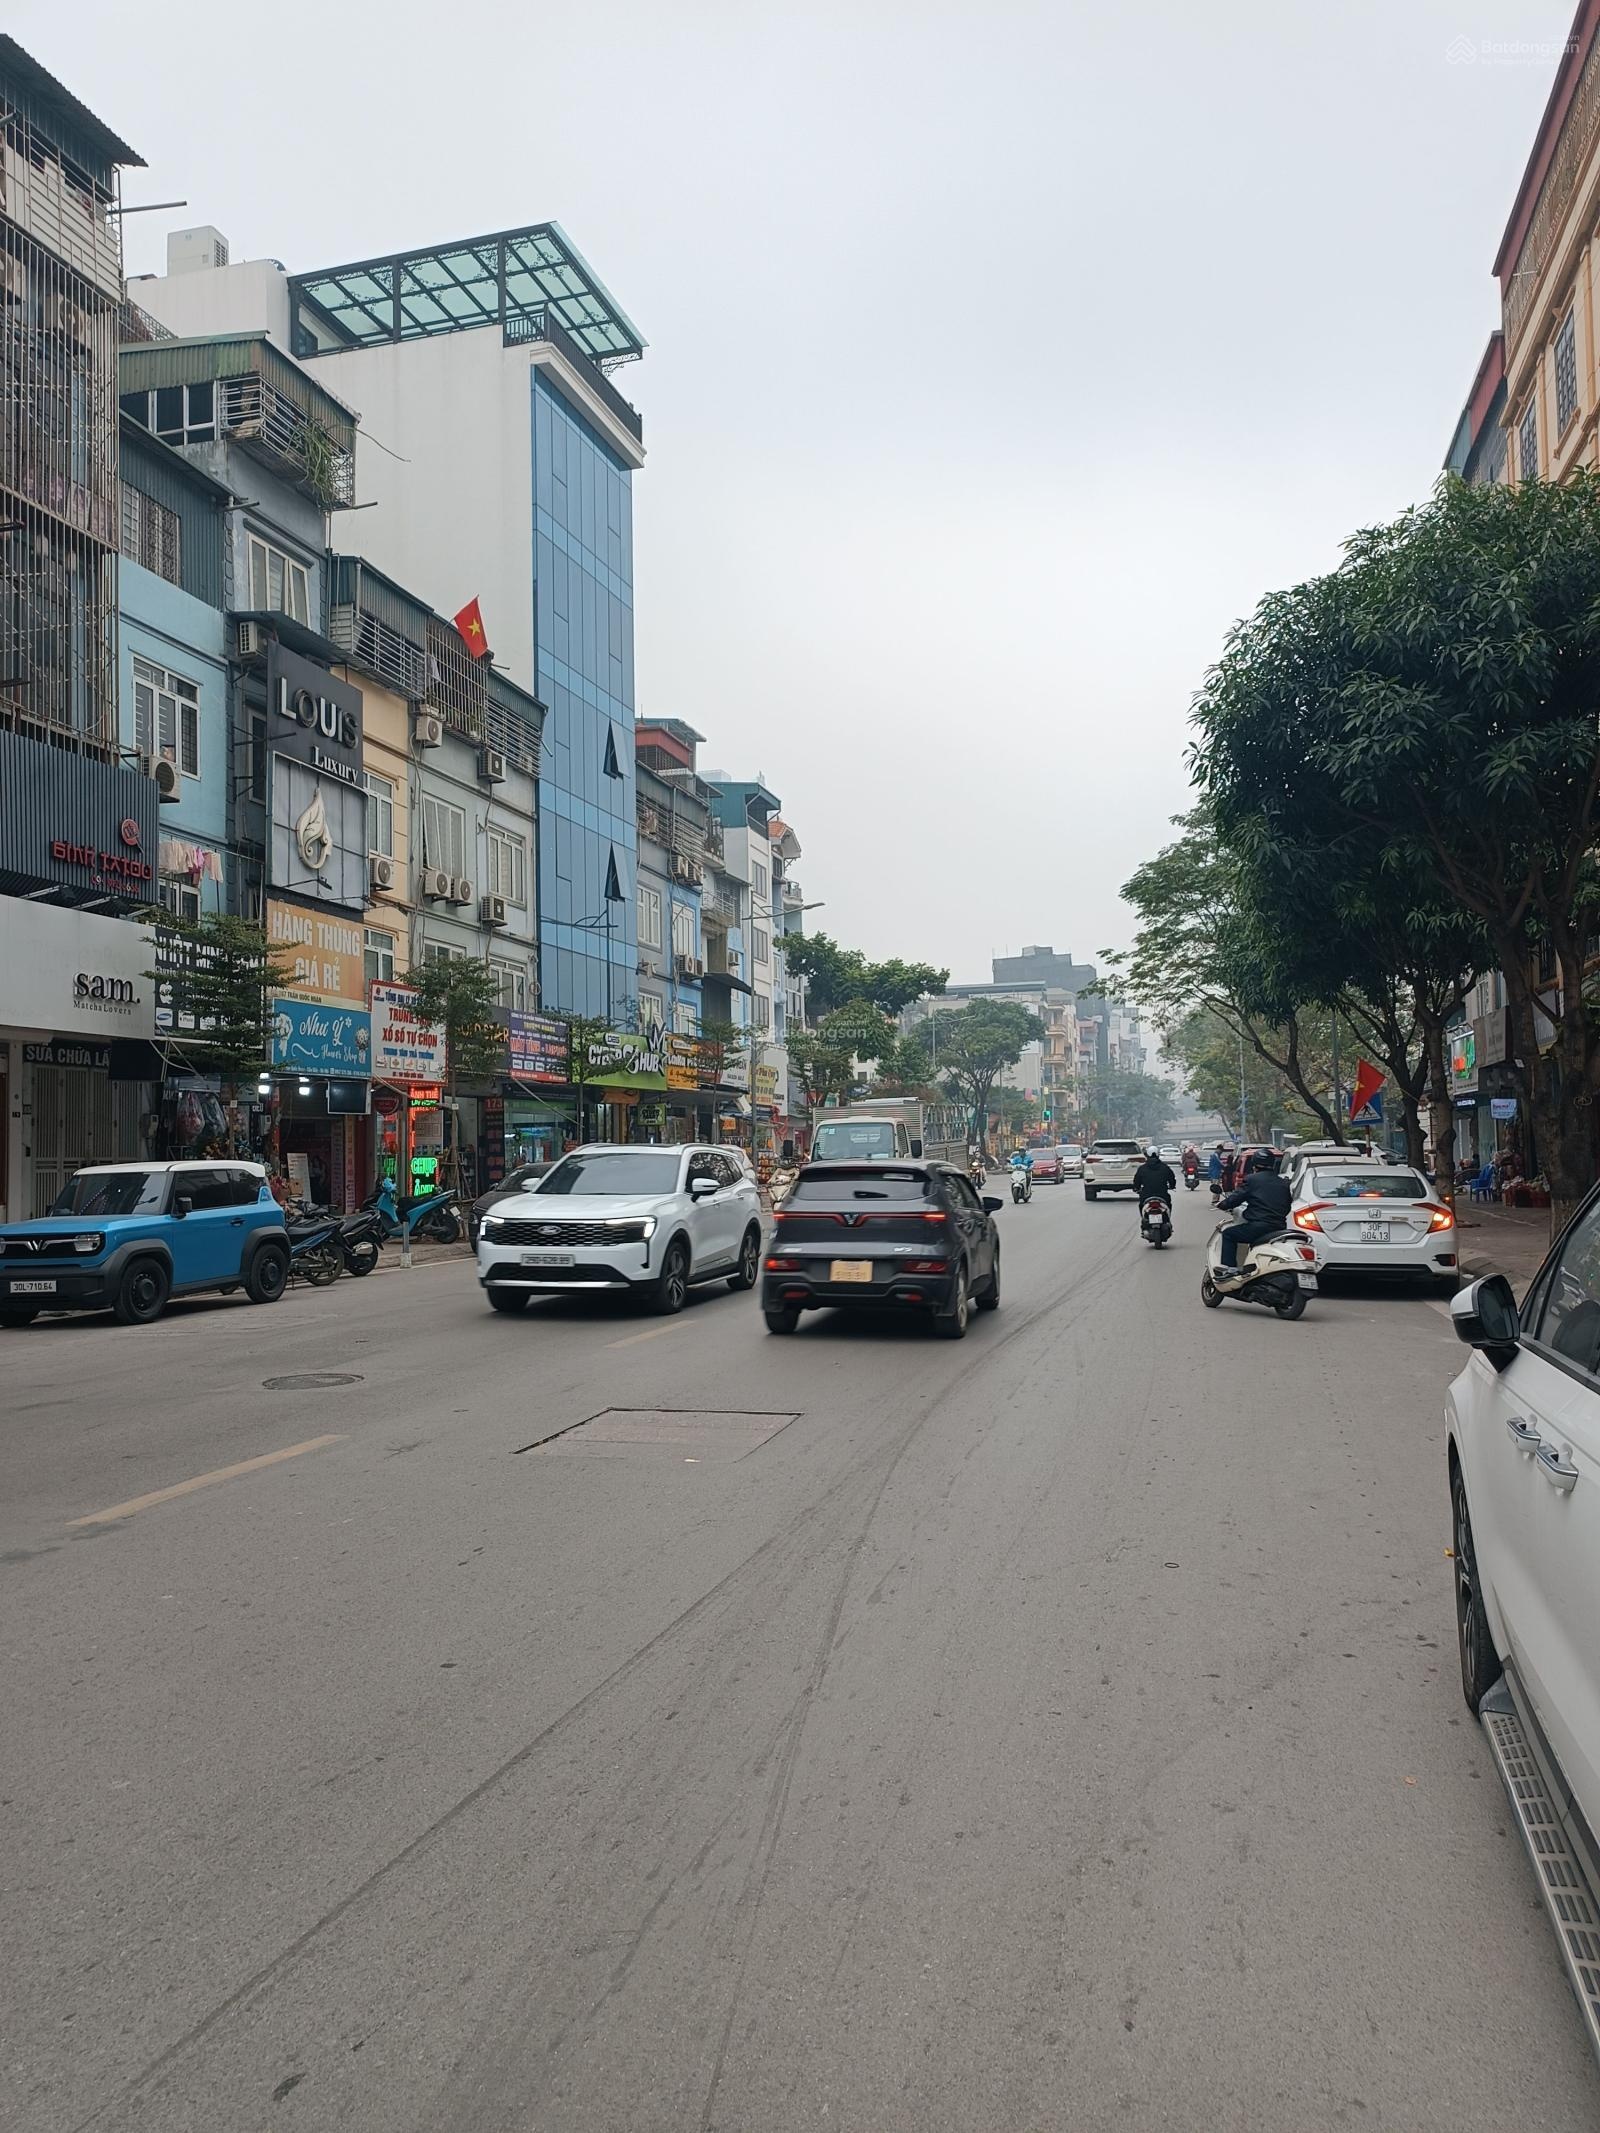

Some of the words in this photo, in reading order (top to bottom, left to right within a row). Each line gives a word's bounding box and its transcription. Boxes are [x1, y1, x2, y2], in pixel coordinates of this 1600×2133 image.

[281, 677, 359, 750] LOUIS
[313, 745, 359, 785] Luxury
[272, 908, 313, 946] HÀNG
[317, 922, 361, 957] THÙNG
[295, 955, 320, 988] GIÁ
[639, 1052, 660, 1072] HUB
[411, 1157, 438, 1177] CHỤP
[1361, 1231, 1389, 1241] 804.13
[1367, 1221, 1382, 1231] 30F
